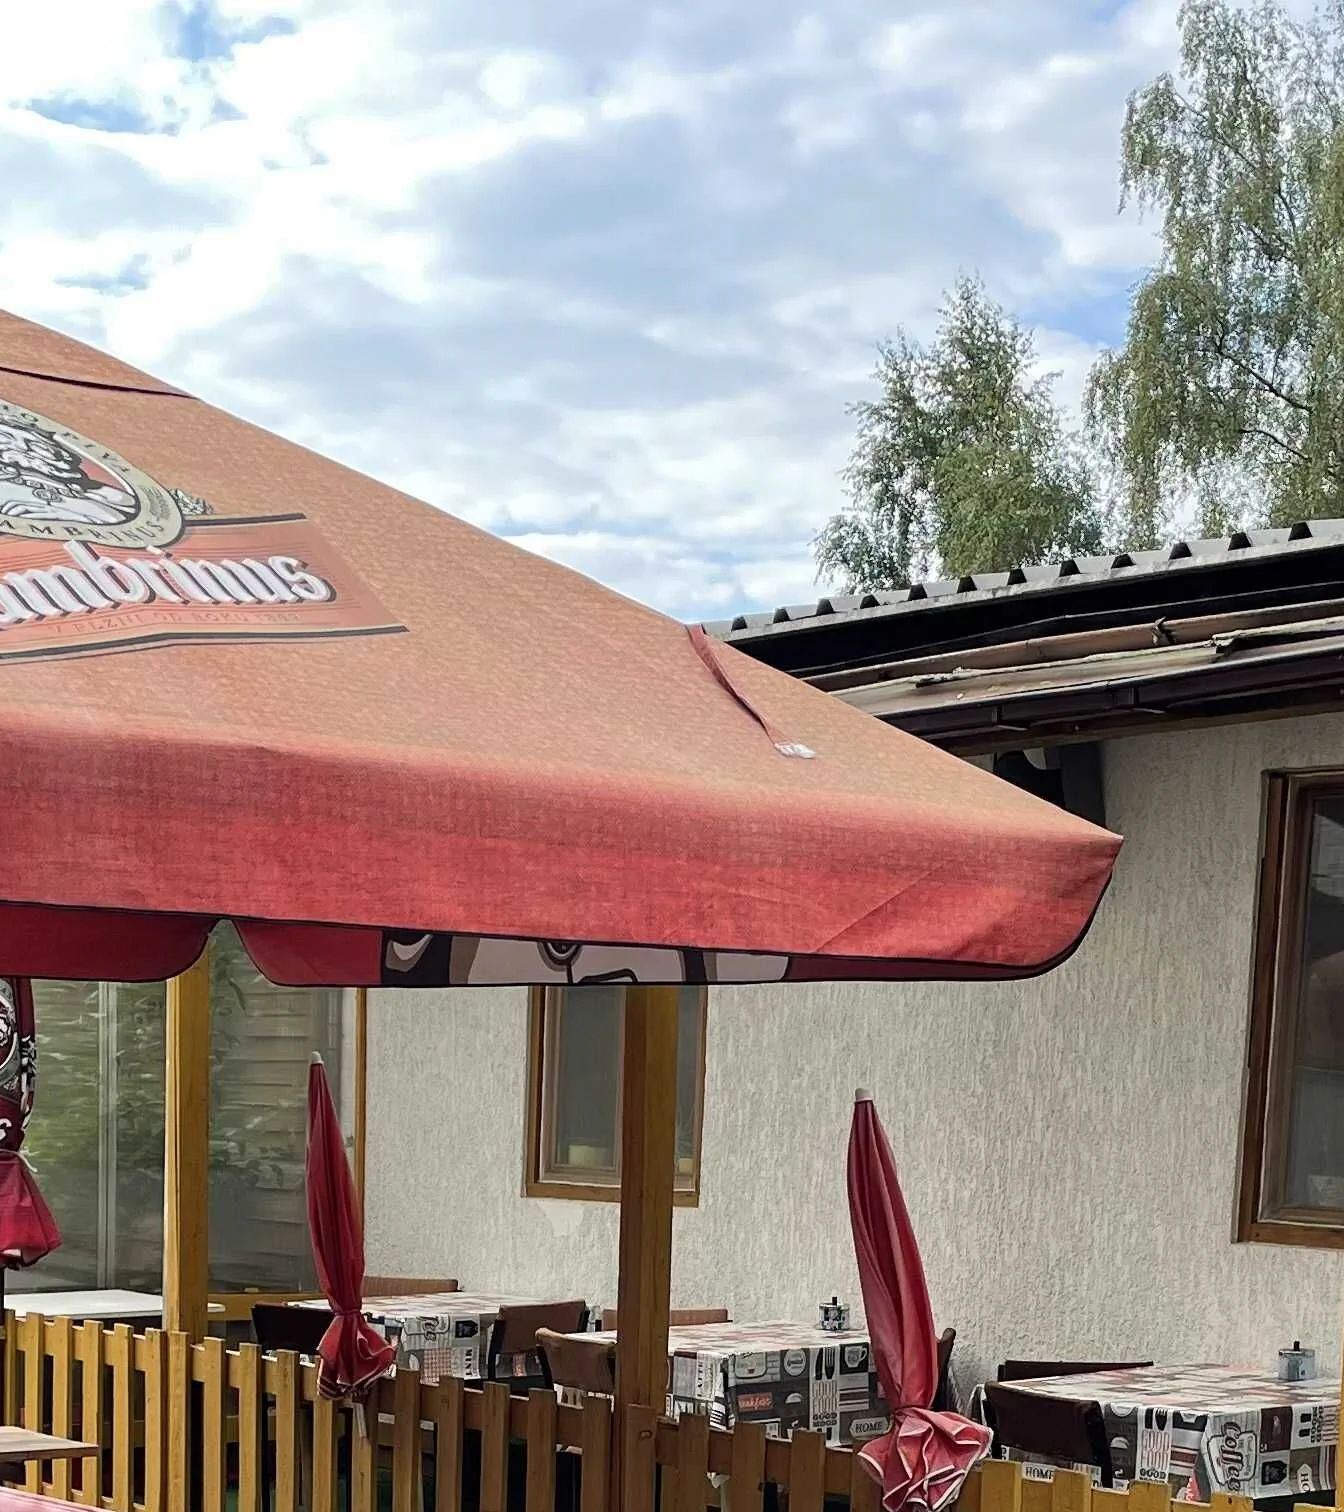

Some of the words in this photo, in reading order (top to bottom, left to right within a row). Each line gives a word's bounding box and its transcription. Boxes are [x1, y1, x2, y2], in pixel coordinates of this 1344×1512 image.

[855, 1421, 884, 1433] HOME
[1220, 1421, 1245, 1491] Coffee
[1139, 1467, 1167, 1479] GOOD
